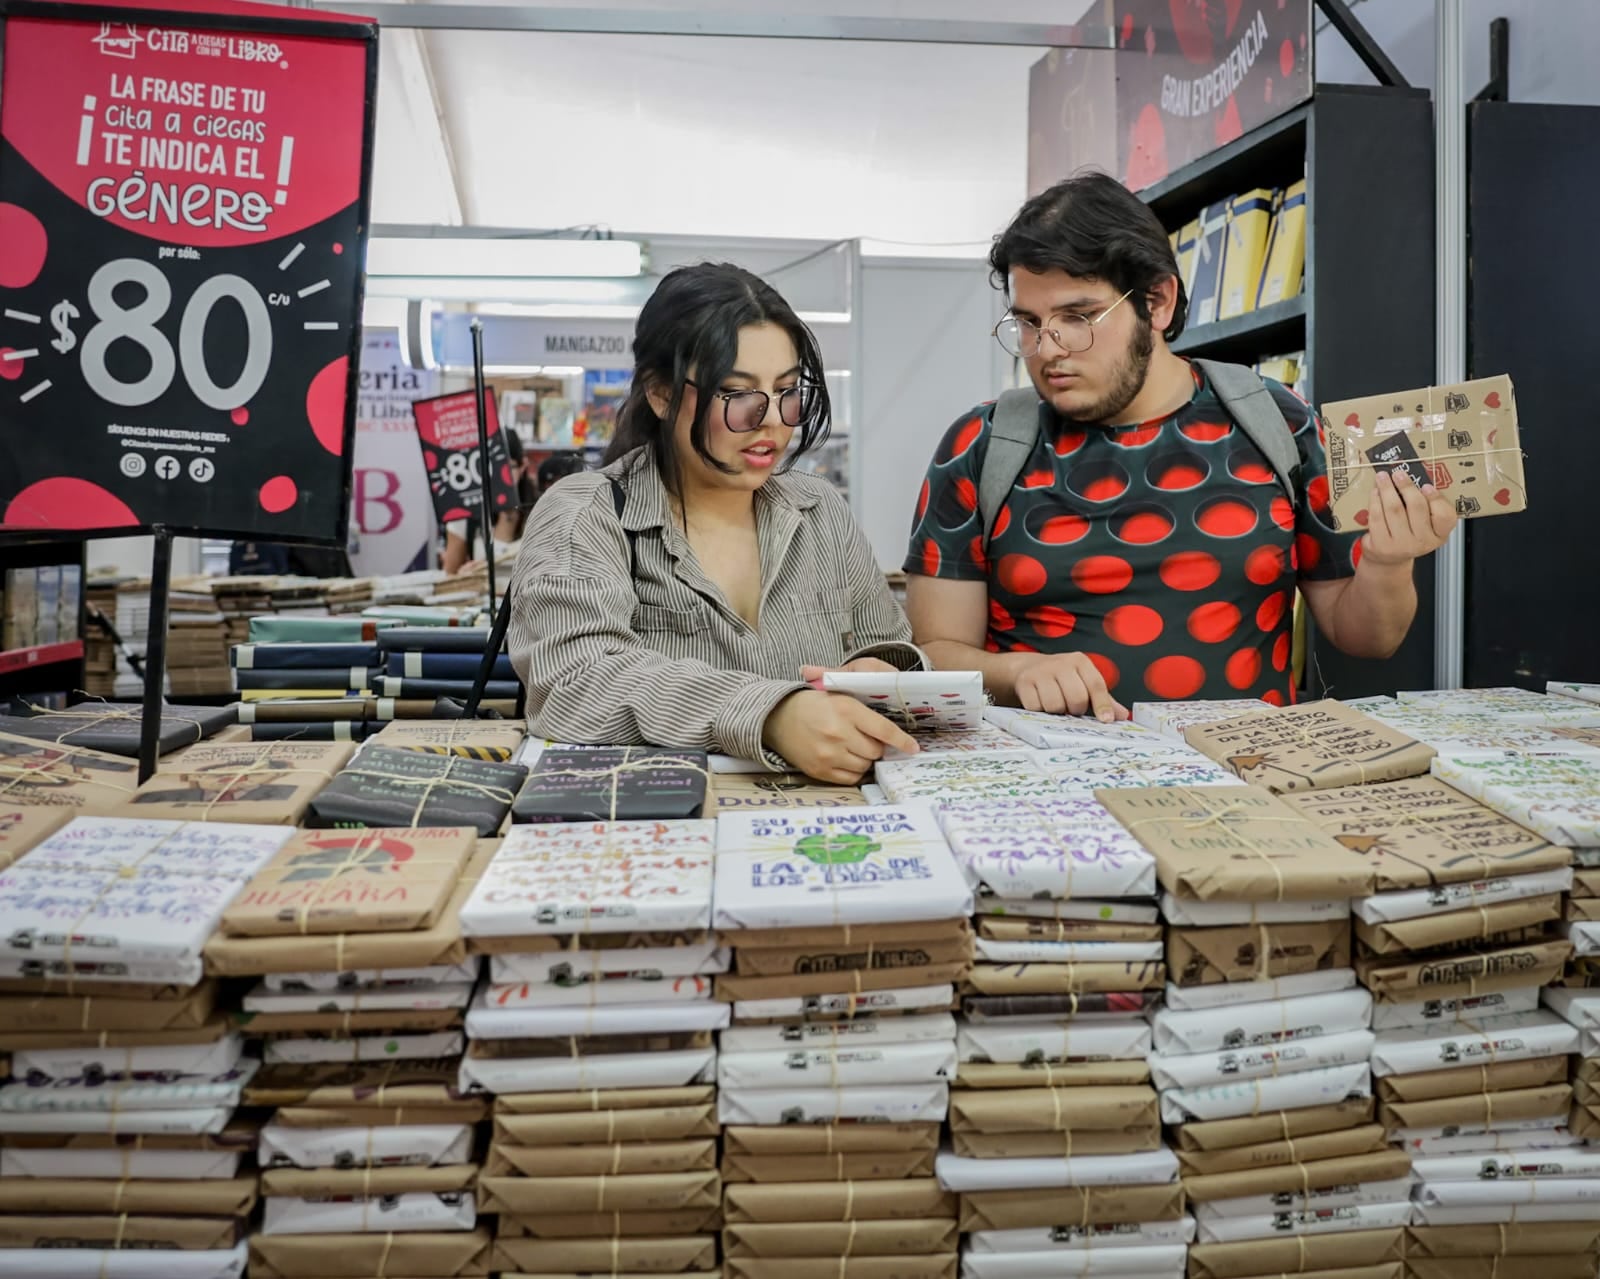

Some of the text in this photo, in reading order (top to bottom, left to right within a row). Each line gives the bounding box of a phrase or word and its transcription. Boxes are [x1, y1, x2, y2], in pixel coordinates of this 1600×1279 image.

[1161, 10, 1269, 117] GRAN EXPERIENCIA
[111, 73, 265, 113] LA FRASE DE TU
[102, 132, 264, 180] TE INDICA EL
[159, 246, 175, 260] por
[80, 258, 273, 411] 80
[358, 364, 420, 391] eria
[1216, 713, 1287, 731] EL GRAN
[1218, 734, 1240, 743] DE
[1243, 730, 1265, 740] LA
[1314, 794, 1337, 802] EL
[1317, 808, 1348, 816] DE
[1351, 804, 1375, 813] LA
